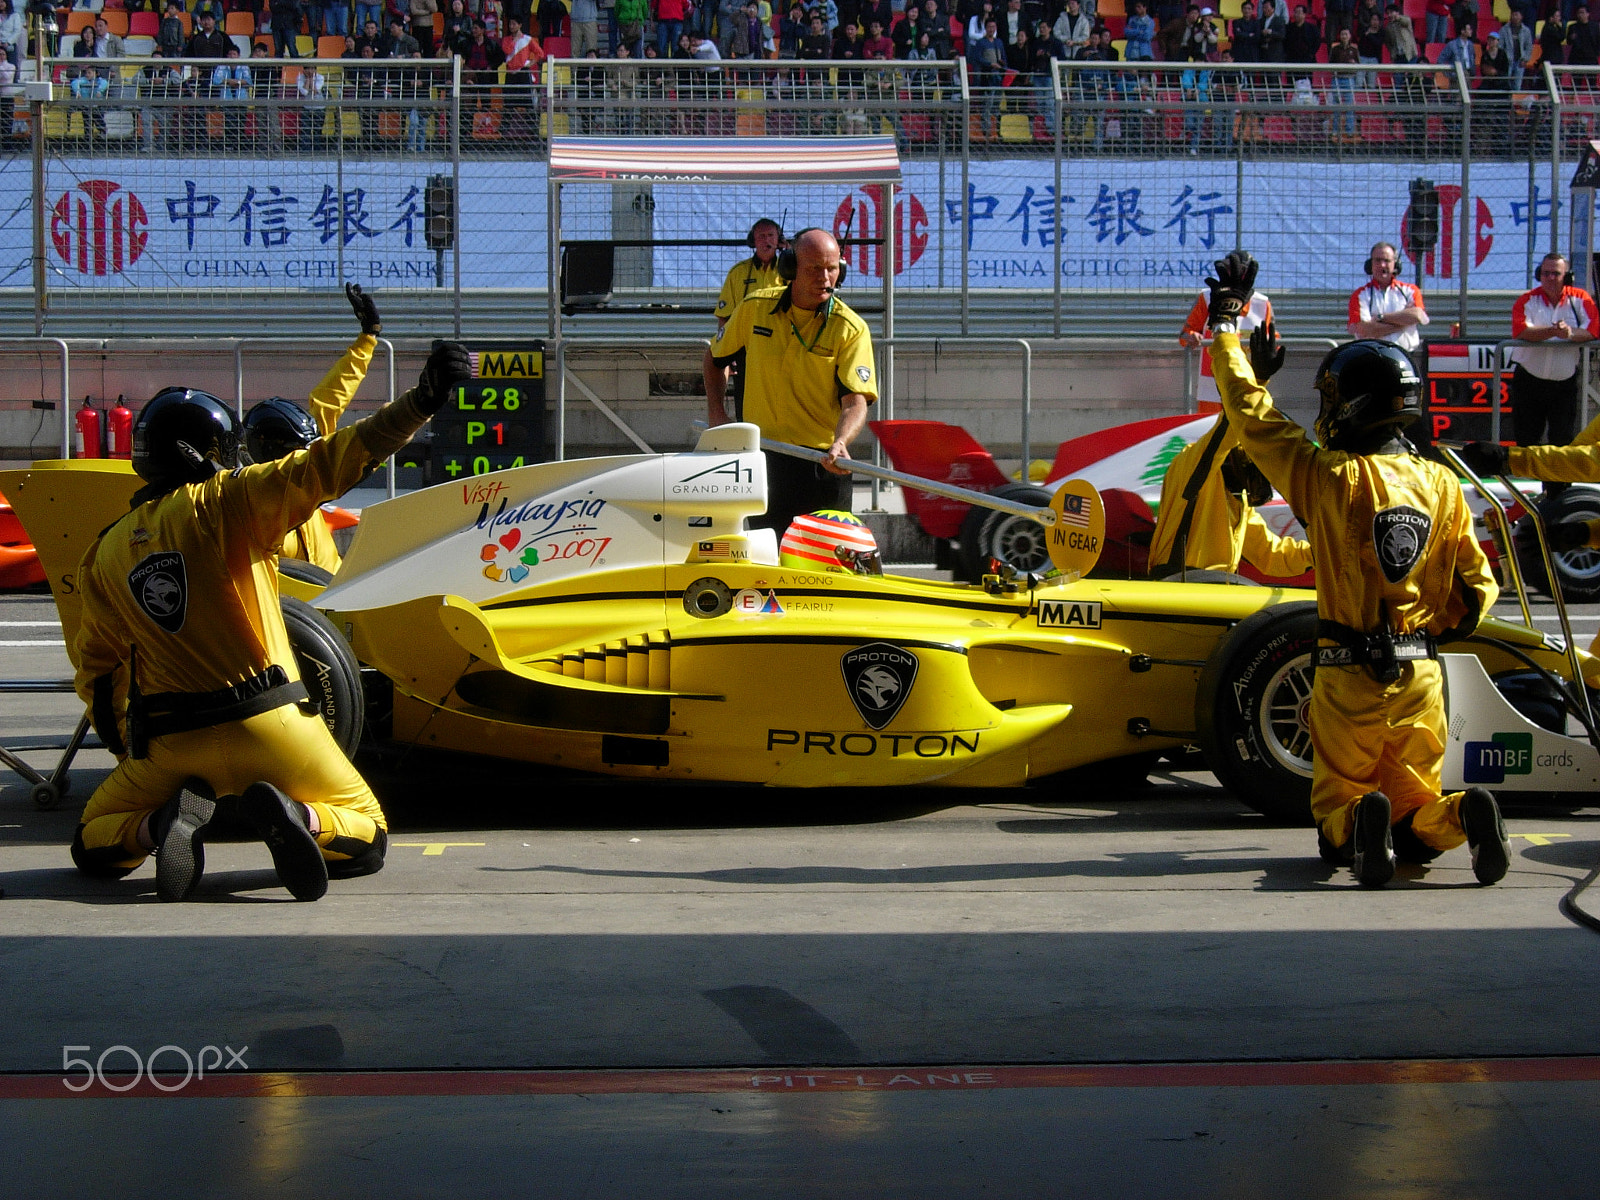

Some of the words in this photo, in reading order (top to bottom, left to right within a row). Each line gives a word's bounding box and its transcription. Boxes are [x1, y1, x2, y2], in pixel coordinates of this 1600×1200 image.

[945, 181, 1233, 250] 中信银行
[184, 259, 270, 278] CHINA
[285, 260, 355, 278] CITIC
[369, 260, 440, 278] BANK
[966, 259, 1047, 278] CHINA
[1062, 258, 1130, 277] CITIC
[1144, 258, 1214, 277] BANK
[481, 354, 539, 377] MAL
[458, 387, 520, 411] L28
[467, 422, 504, 445] P1
[1432, 415, 1451, 438] P
[463, 481, 510, 505] Visit
[672, 485, 719, 494] GRAND
[724, 485, 753, 494] PRIX
[462, 491, 607, 539] Malaysia
[1379, 514, 1429, 529] PROTON
[1053, 528, 1066, 547] IN
[1068, 531, 1099, 553] GEAR
[543, 538, 612, 568] 2007
[731, 550, 749, 559] MAL
[131, 557, 179, 583] PROTON
[778, 576, 788, 585] A.
[792, 576, 833, 585] YOONG
[743, 595, 755, 609] E
[1040, 603, 1098, 626] MAL
[847, 652, 912, 666] PROTON
[1243, 649, 1269, 680] GRAND
[1267, 633, 1287, 651] PRIX
[321, 680, 336, 716] GRAND
[767, 728, 980, 758] PROTON
[1536, 749, 1573, 767] cards
